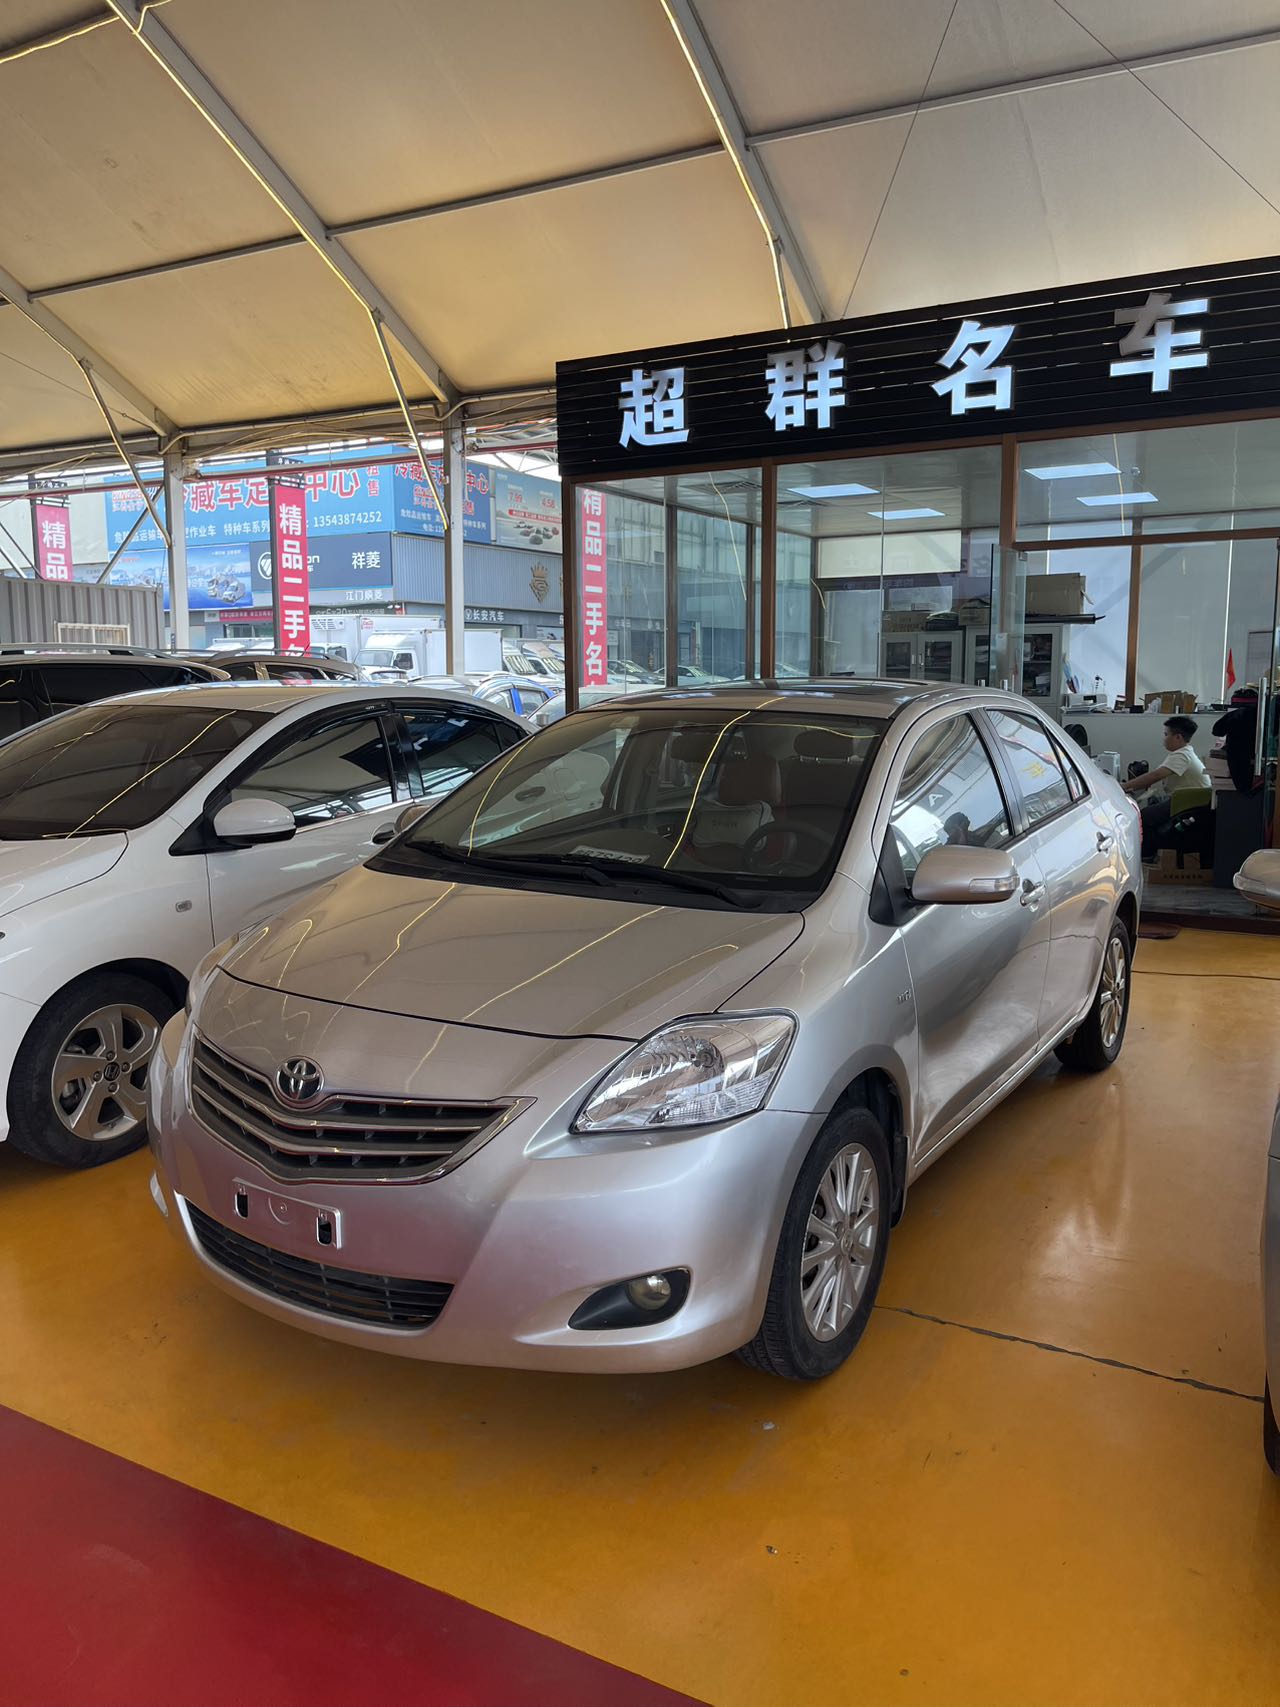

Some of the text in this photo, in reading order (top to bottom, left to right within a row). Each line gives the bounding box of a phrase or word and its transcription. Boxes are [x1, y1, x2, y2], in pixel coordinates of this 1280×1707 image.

[617, 291, 1210, 448] 超群名车
[313, 511, 382, 529] 13543874252
[351, 551, 381, 569] 祥菱
